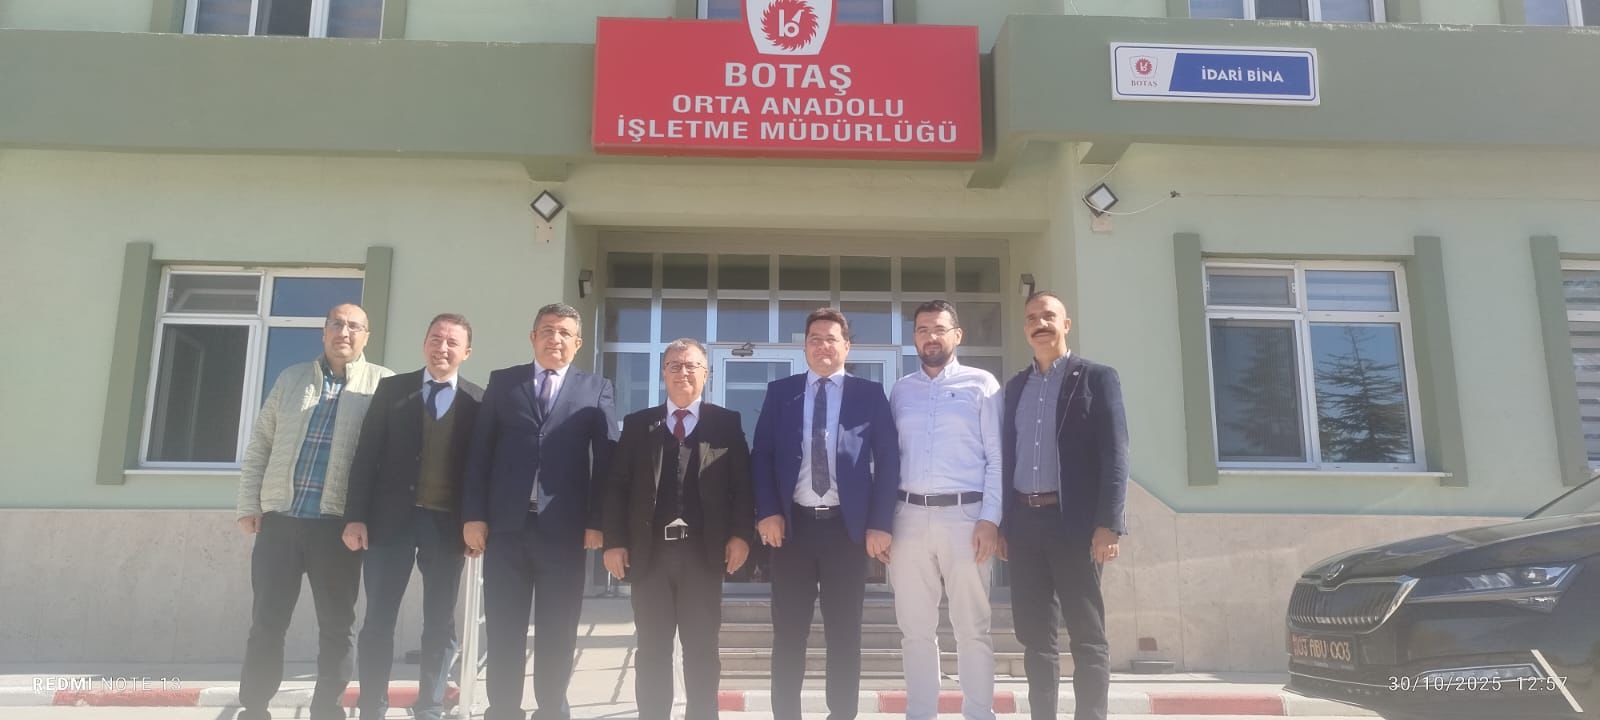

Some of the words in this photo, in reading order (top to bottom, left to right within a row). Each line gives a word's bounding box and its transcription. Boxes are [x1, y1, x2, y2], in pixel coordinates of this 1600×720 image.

[725, 62, 852, 96] BOTAŞ
[1201, 65, 1242, 81] İDARİ
[1247, 67, 1284, 83] BİNA
[672, 94, 750, 115] ORTA
[761, 96, 904, 118] ANADOLU
[617, 114, 749, 143] İŞLETME
[760, 118, 957, 144] MÜDÜRLÜĞÜ
[1330, 640, 1351, 662] 003
